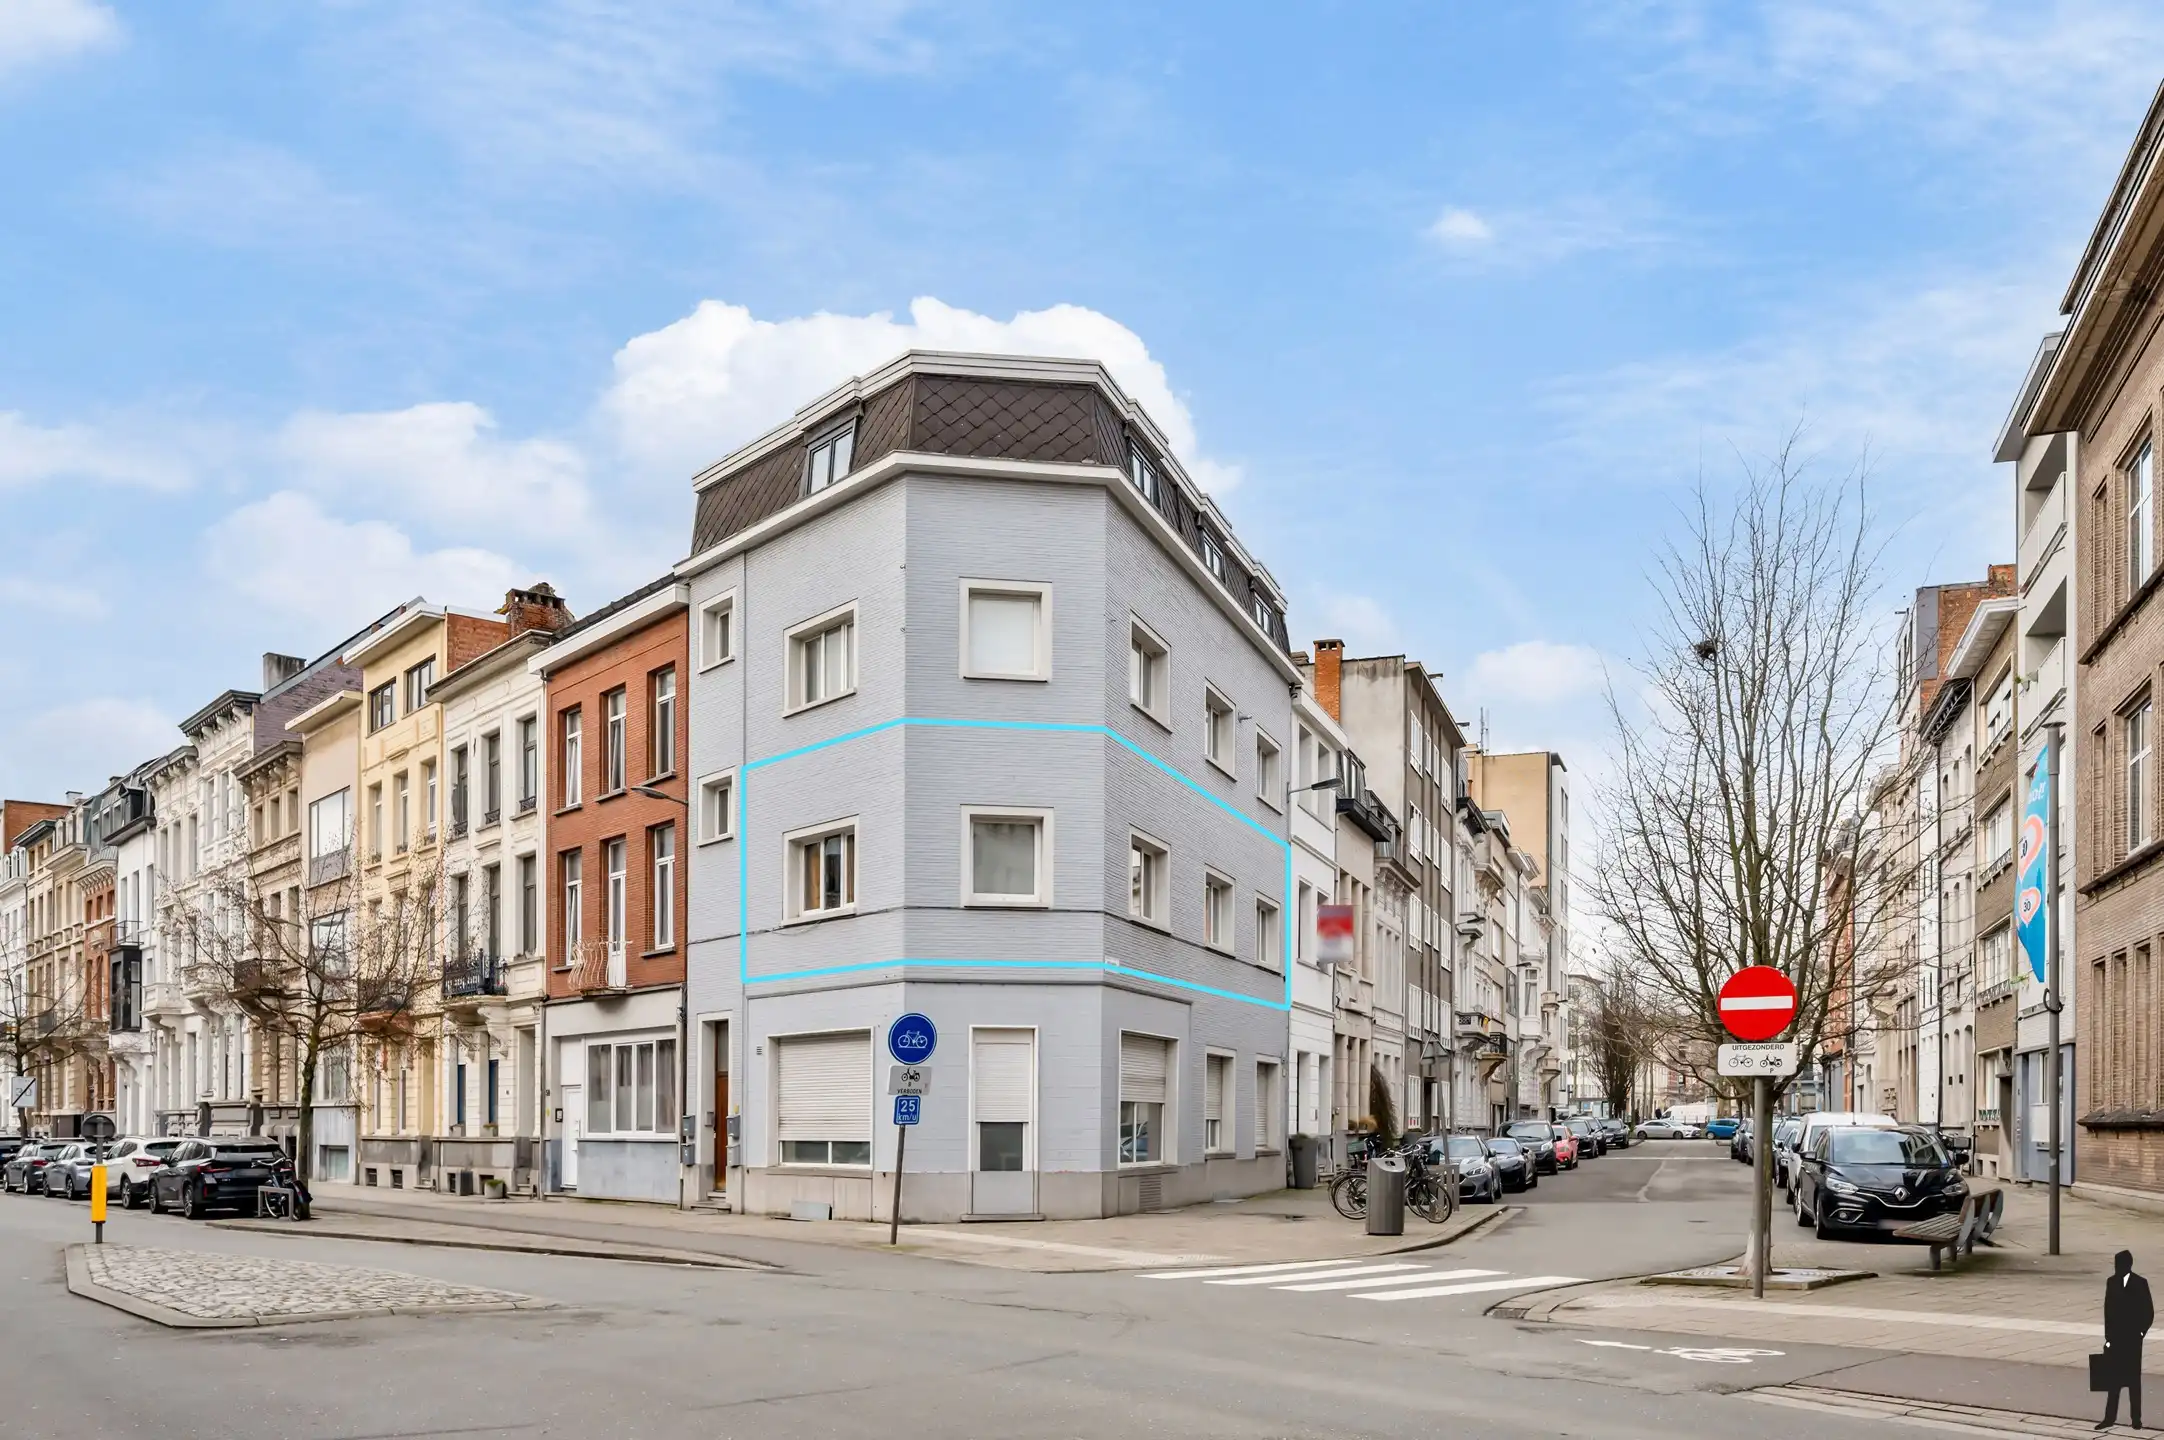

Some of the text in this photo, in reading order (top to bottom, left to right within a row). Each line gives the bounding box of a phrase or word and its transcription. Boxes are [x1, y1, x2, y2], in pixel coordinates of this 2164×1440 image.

[2023, 900, 2031, 912] 30
[15, 1087, 32, 1097] 30
[900, 1100, 916, 1112] 25
[898, 1112, 917, 1121] km/u
